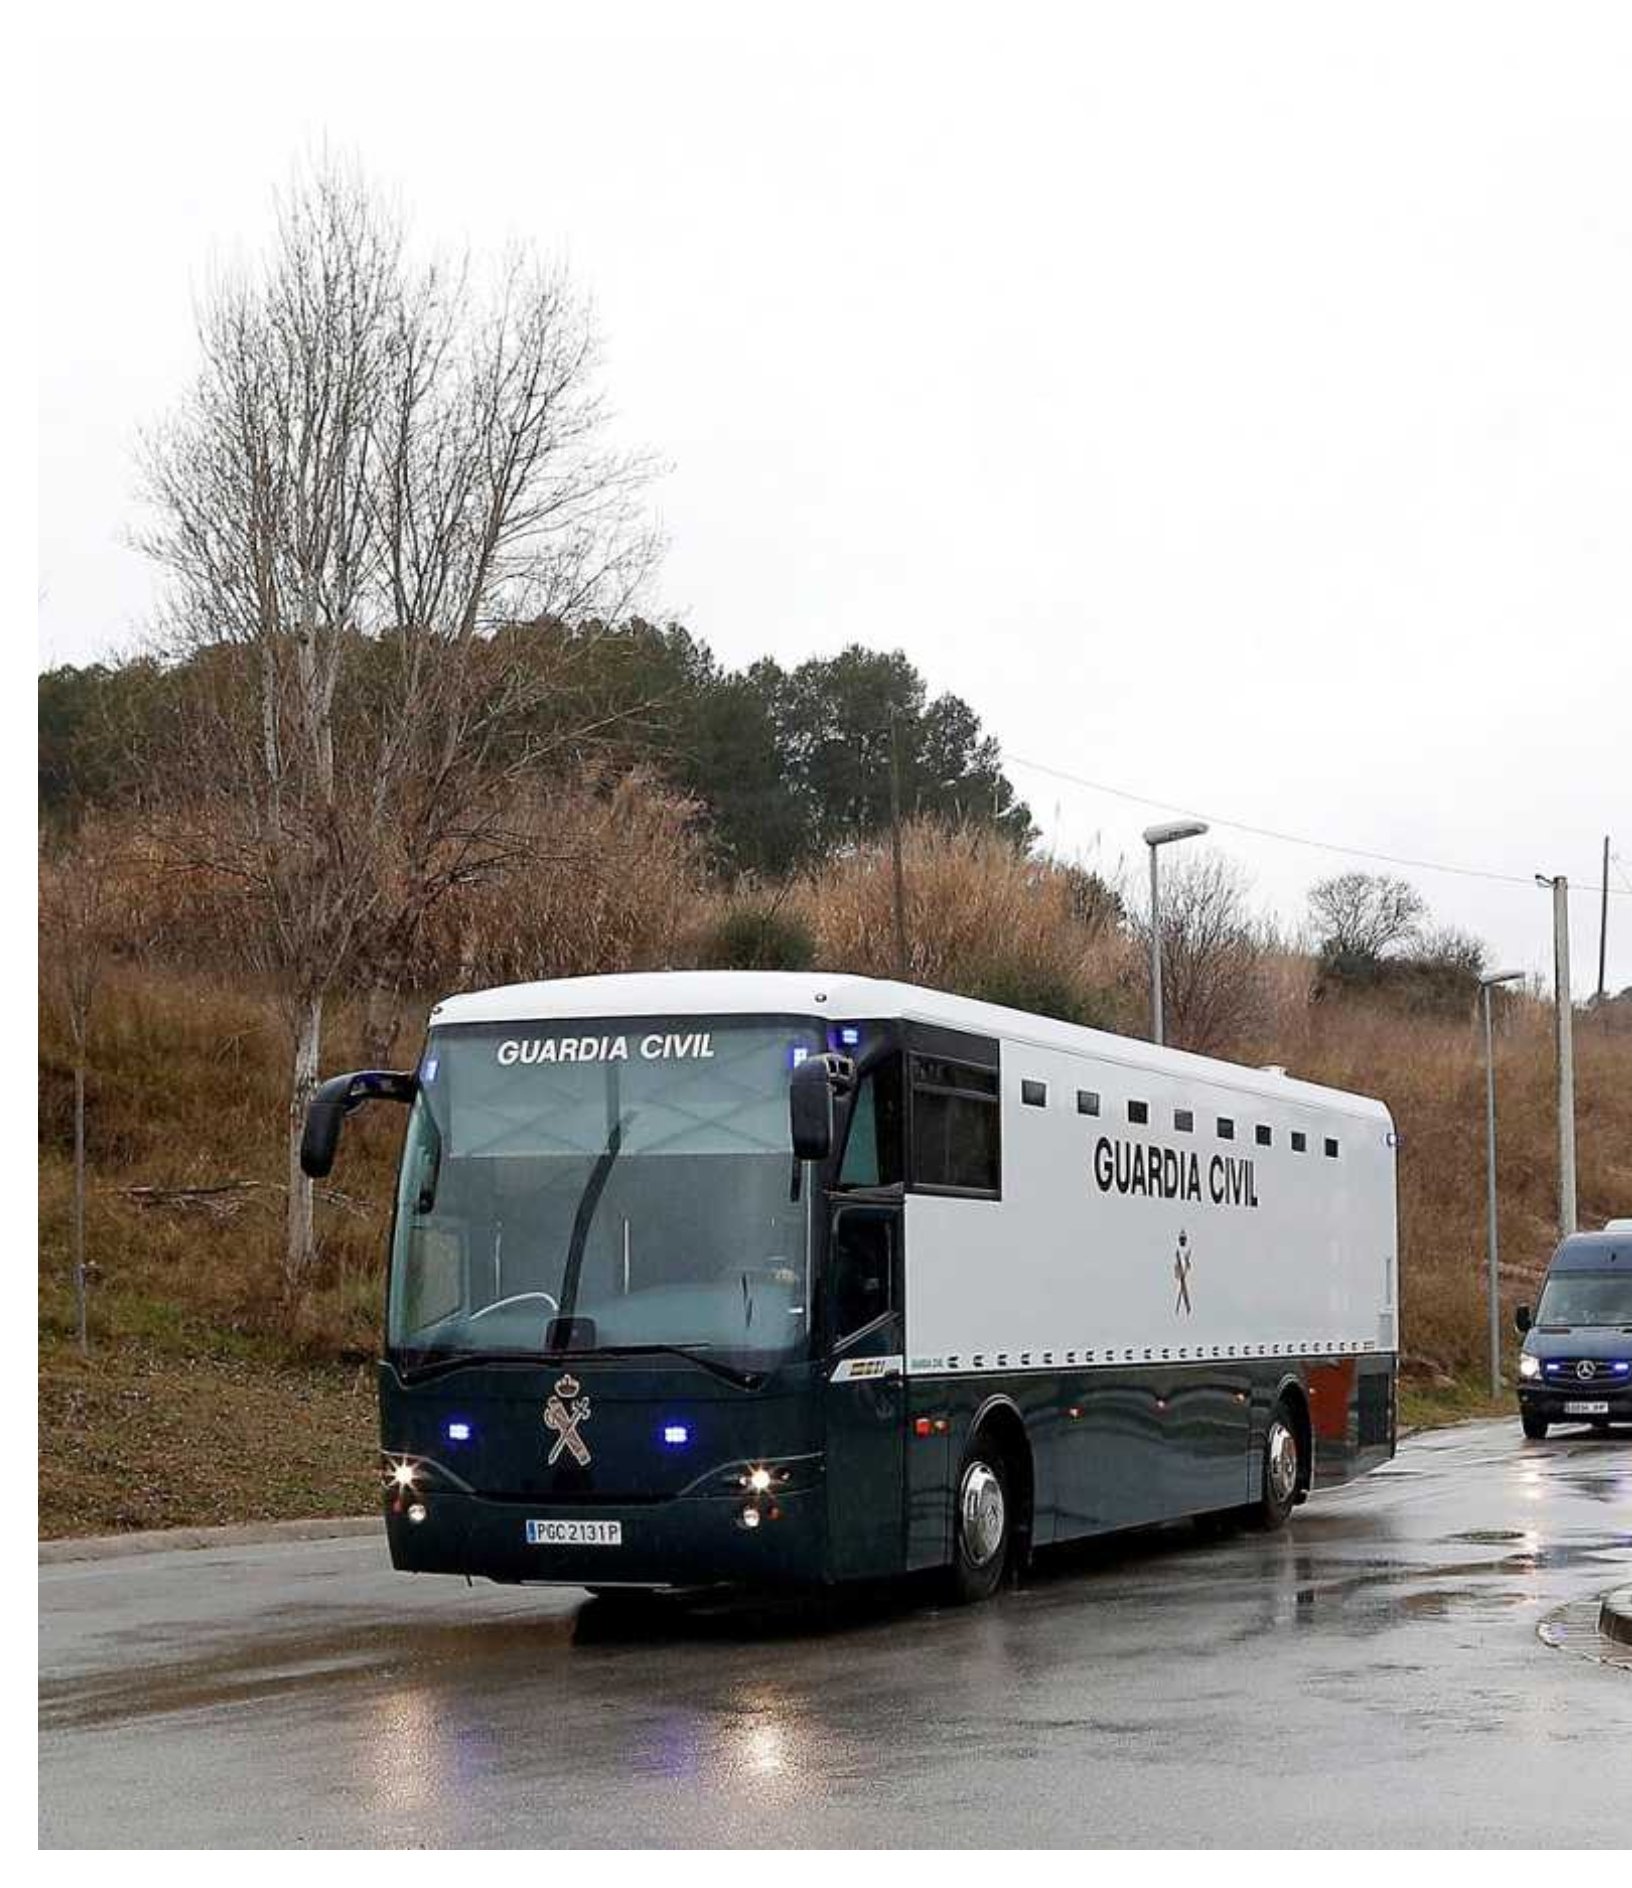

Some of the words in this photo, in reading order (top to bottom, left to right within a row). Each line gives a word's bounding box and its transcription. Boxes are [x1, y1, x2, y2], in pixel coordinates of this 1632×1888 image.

[498, 1036, 628, 1064] GUARDIA
[641, 1033, 715, 1059] CIVIL
[1094, 1136, 1202, 1203] GUARDIA
[1209, 1154, 1258, 1208] CIVIL
